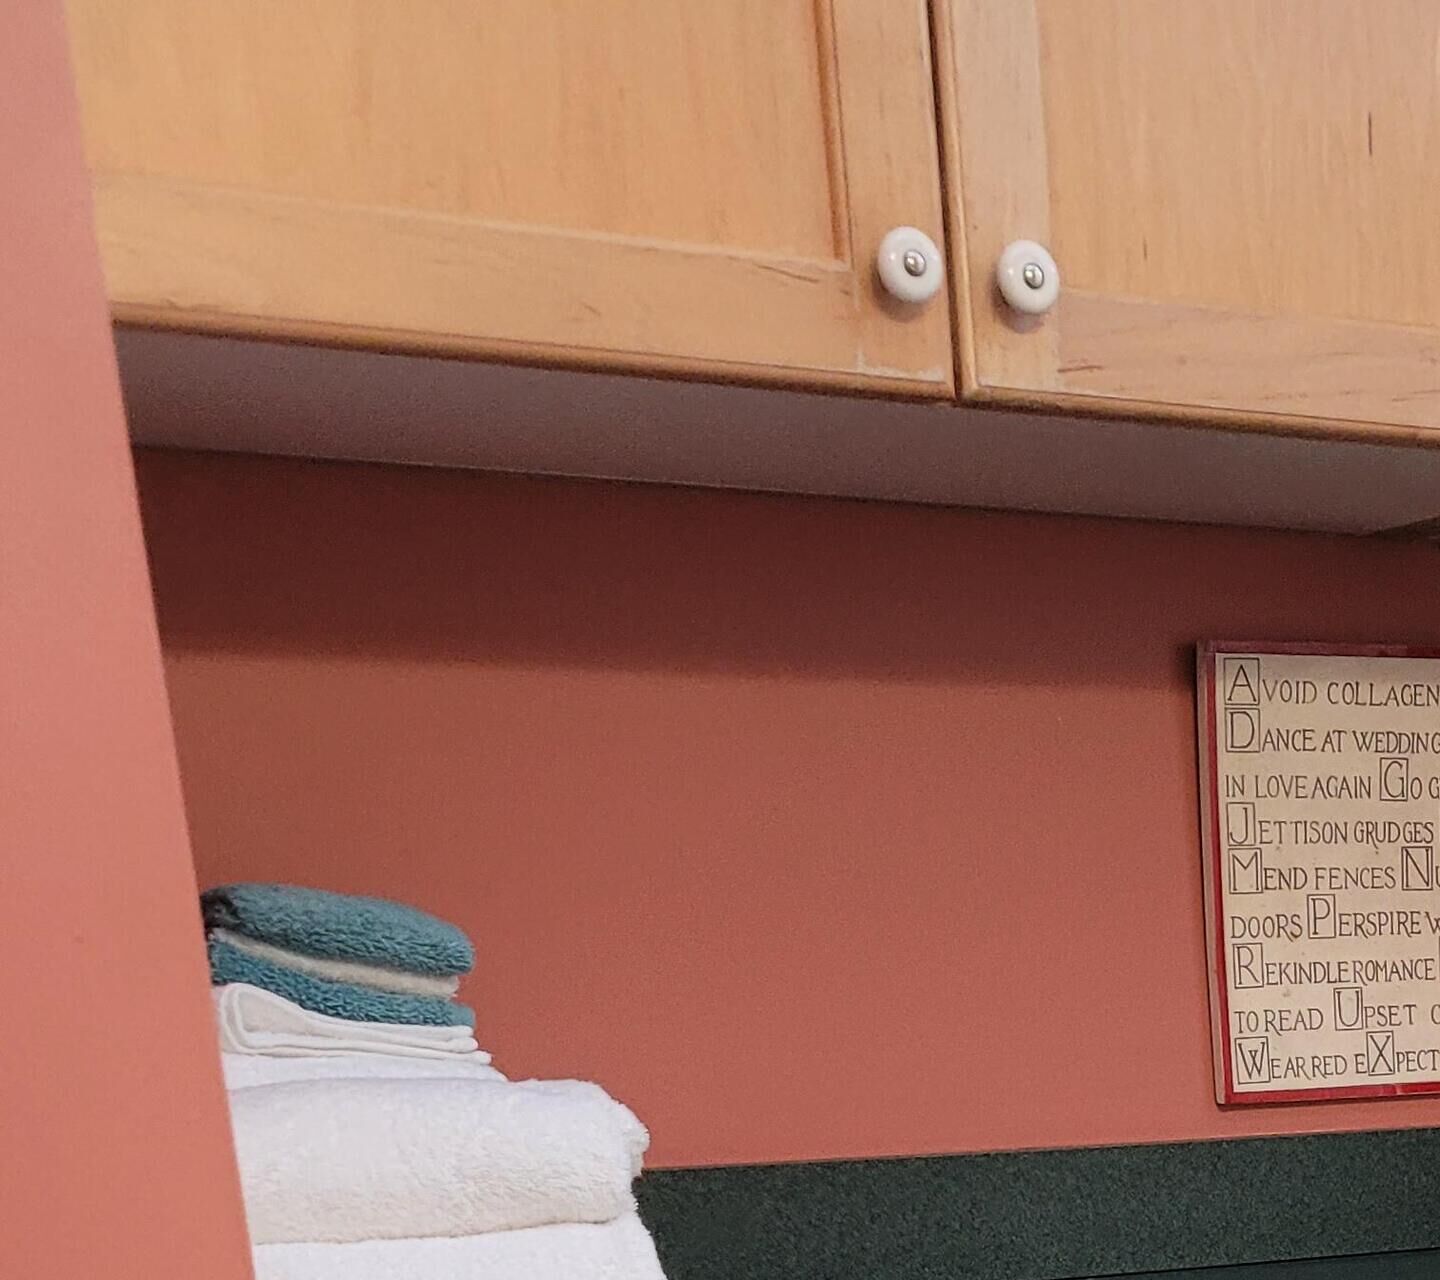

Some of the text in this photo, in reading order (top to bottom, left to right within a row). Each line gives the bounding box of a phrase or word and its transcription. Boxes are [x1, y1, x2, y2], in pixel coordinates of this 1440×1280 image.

[1228, 664, 1317, 705] AVOID
[1327, 682, 1439, 707] COLLAGEN
[1229, 711, 1316, 752] DANCE
[1321, 730, 1347, 753] AT
[1225, 775, 1244, 798] IN
[1255, 776, 1308, 798] LOVE
[1311, 776, 1371, 799] AGAIN
[1384, 761, 1422, 799] GO
[1229, 807, 1348, 845] JETTISON
[1354, 821, 1434, 849] GRUDGES
[1232, 852, 1307, 891] MEND
[1315, 867, 1396, 889] FENCES
[1231, 914, 1302, 942] DOORS
[1311, 898, 1421, 939] PERSPIRE
[1237, 946, 1349, 985] REKINDLE
[1354, 958, 1434, 985] ROMANCE
[1234, 1011, 1259, 1033] TO
[1264, 1008, 1323, 1035] READ
[1336, 991, 1417, 1028] UPSET
[1238, 1042, 1311, 1080] WEAR
[1312, 1055, 1347, 1079] RED
